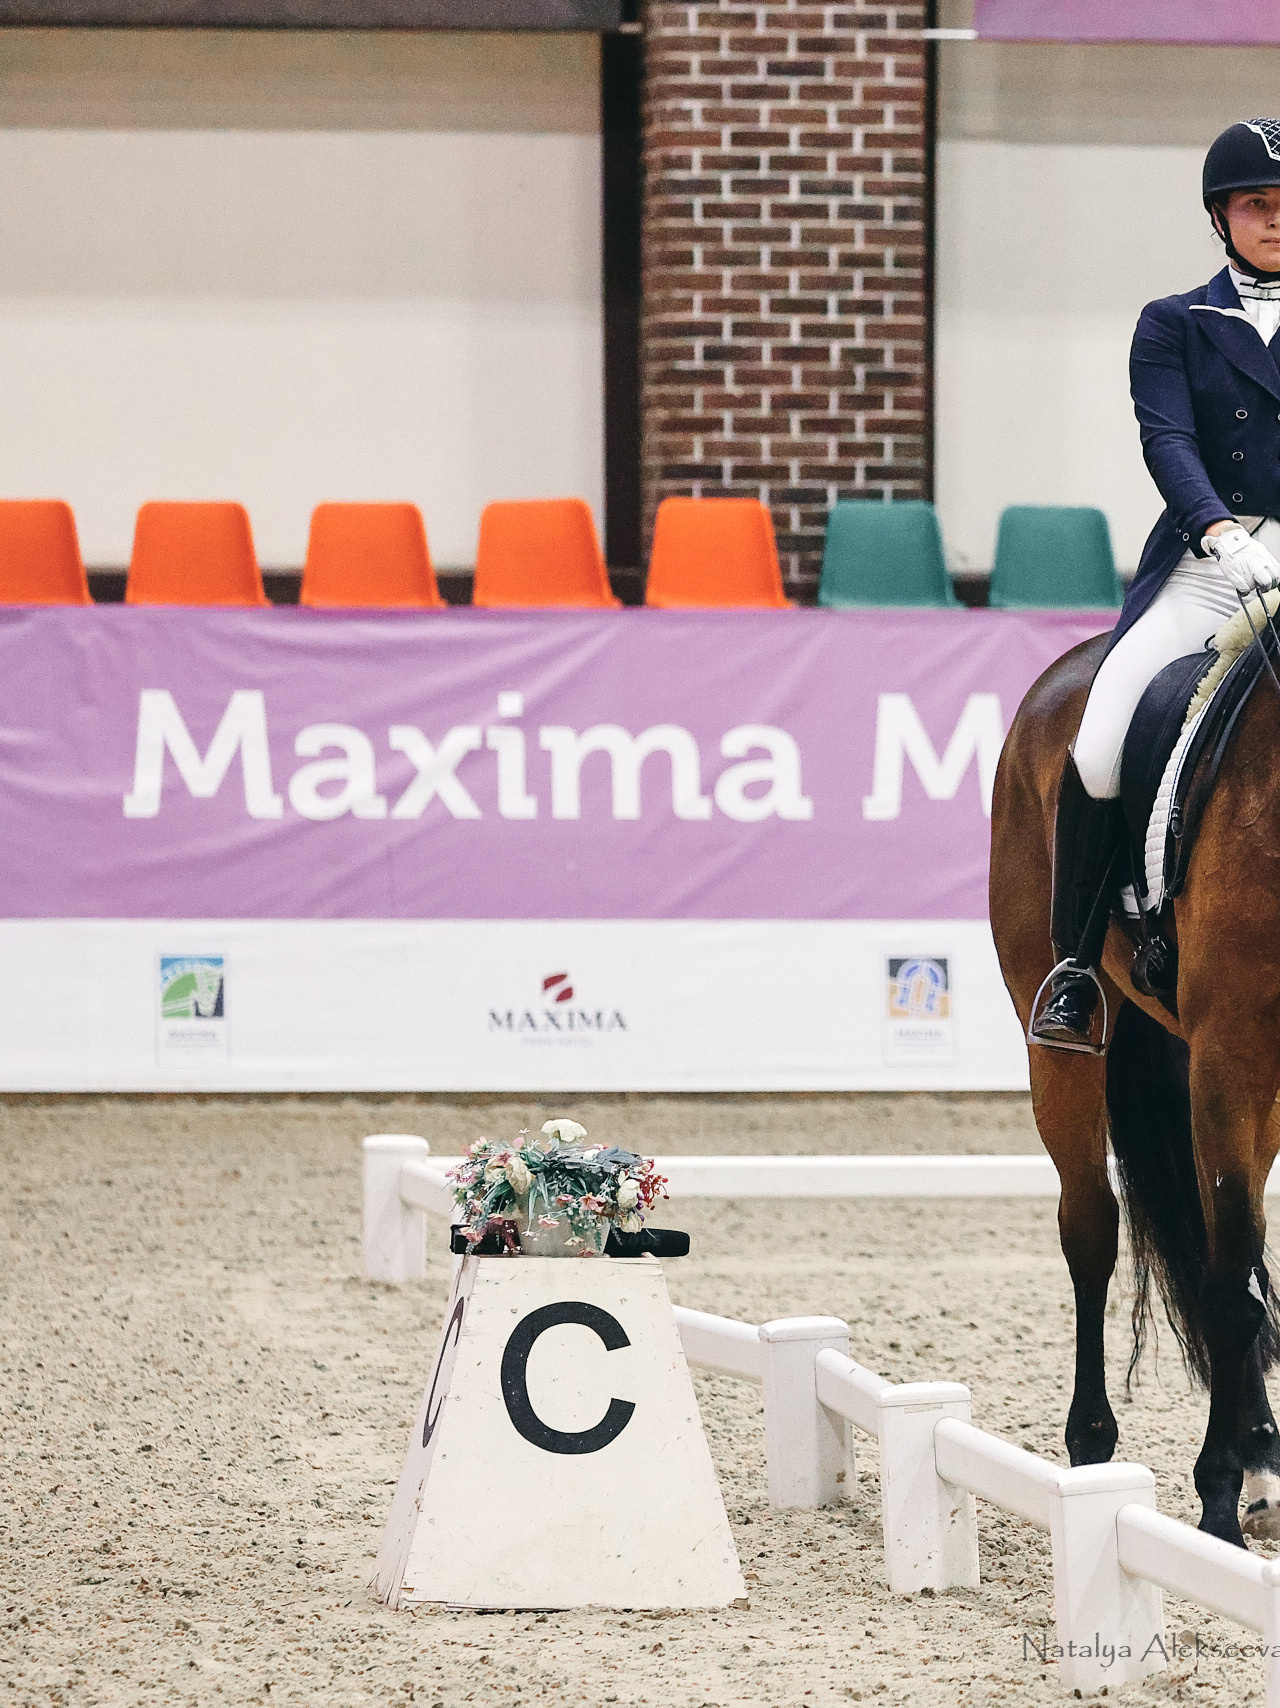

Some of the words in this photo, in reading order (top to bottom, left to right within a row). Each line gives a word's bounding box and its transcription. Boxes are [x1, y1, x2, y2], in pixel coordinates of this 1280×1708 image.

[122, 688, 814, 822] Maxima
[487, 1008, 629, 1033] MAXIMA
[500, 1301, 636, 1455] C
